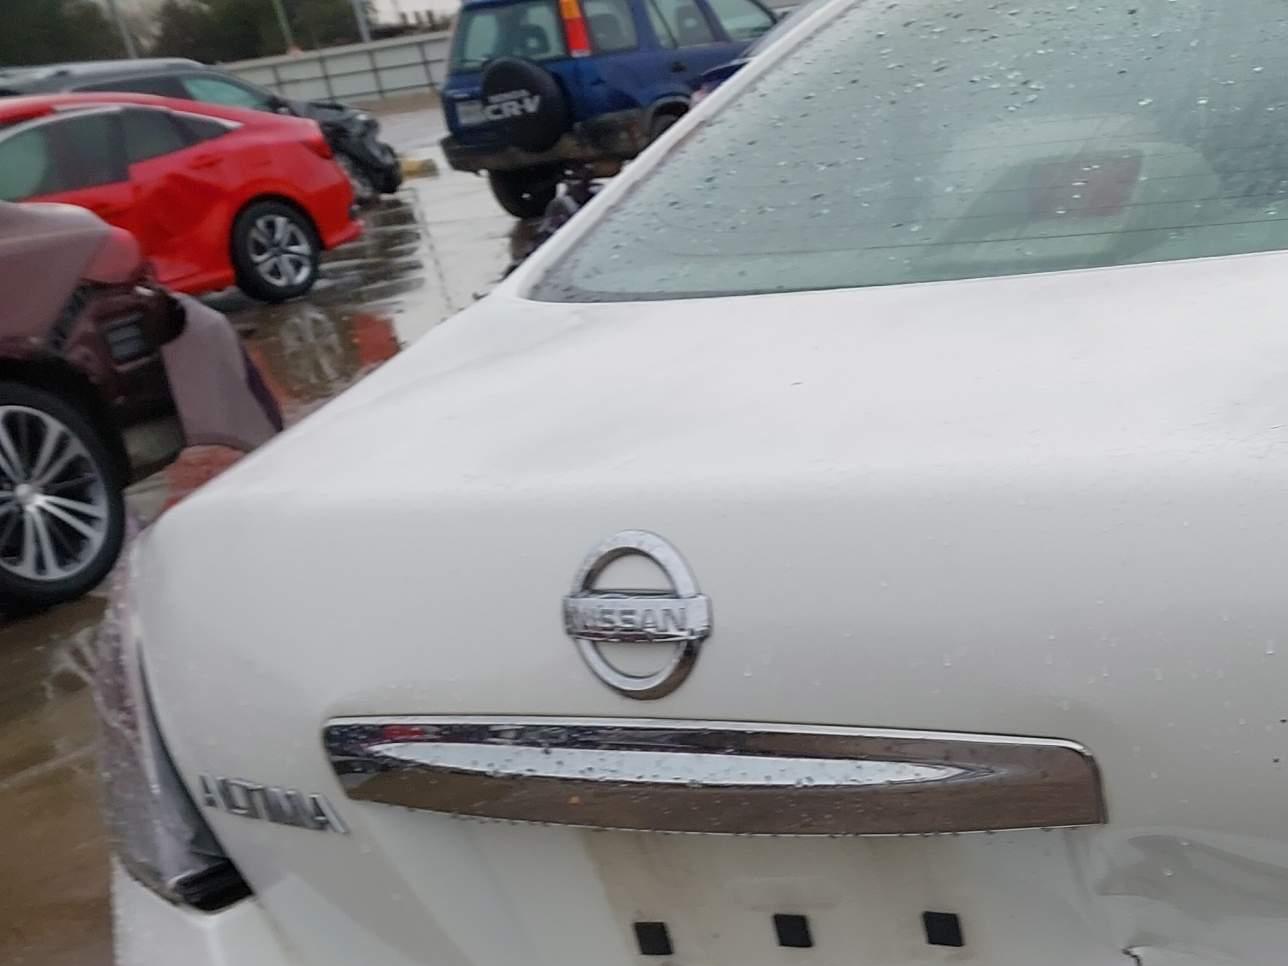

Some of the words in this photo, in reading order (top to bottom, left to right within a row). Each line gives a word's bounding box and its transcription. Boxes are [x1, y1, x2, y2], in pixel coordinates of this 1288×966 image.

[484, 95, 541, 120] CR-V
[567, 606, 688, 632] NISSAN
[198, 771, 351, 834] ALTIMA
